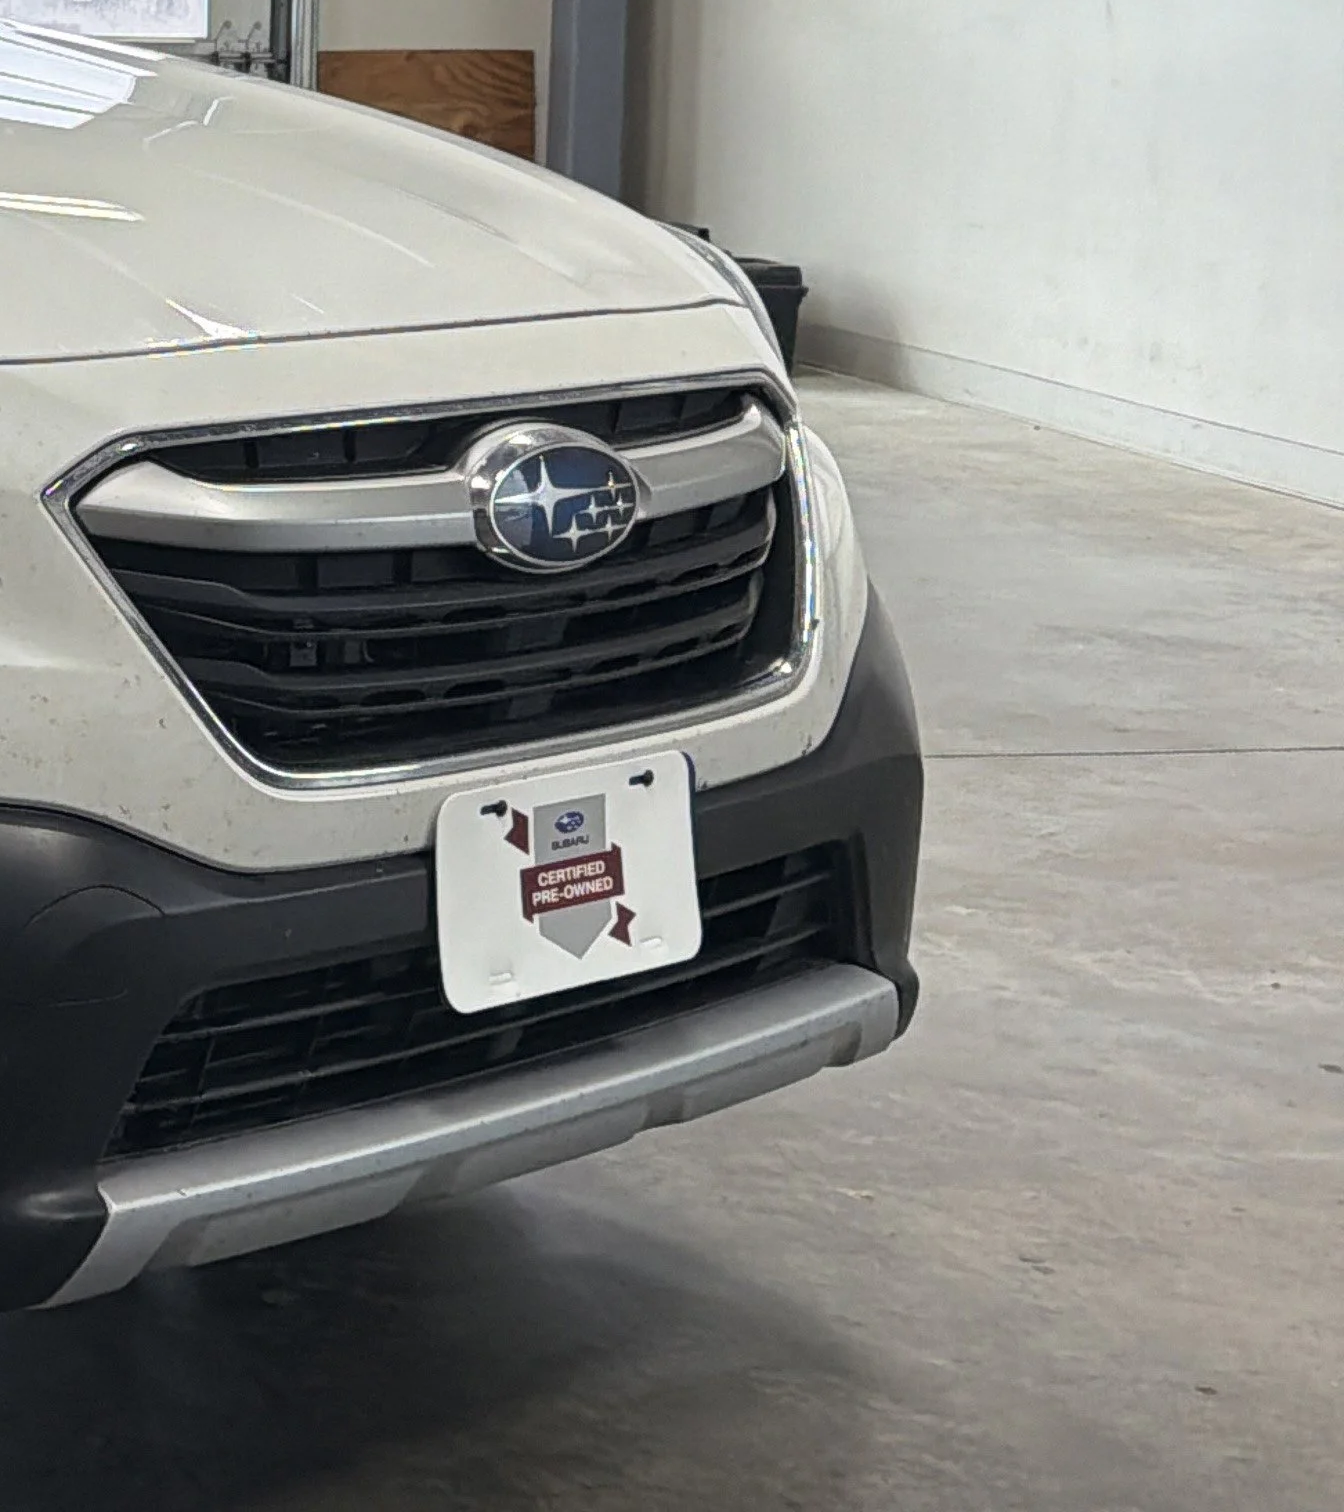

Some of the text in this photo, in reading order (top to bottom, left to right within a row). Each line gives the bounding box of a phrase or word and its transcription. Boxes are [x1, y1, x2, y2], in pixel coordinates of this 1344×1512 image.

[551, 834, 590, 851] SUBARU
[537, 860, 607, 887] CERTIFIED
[531, 875, 614, 907] PRE-OWNED
